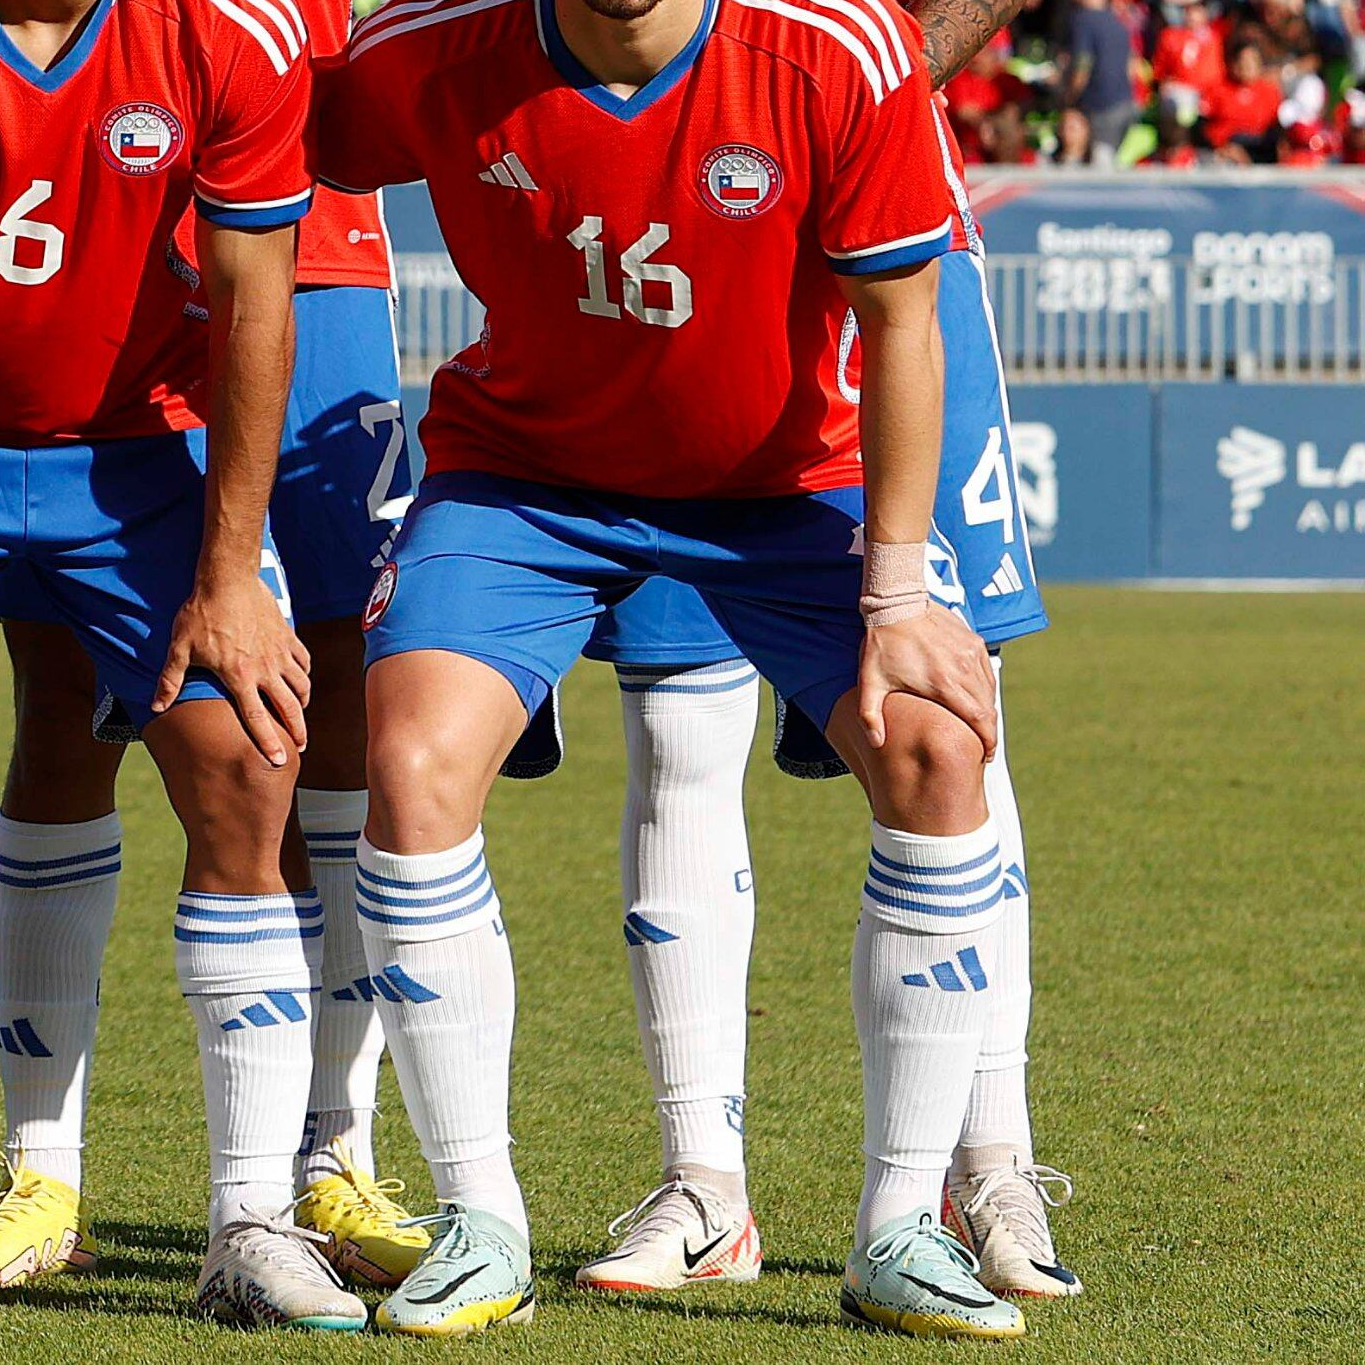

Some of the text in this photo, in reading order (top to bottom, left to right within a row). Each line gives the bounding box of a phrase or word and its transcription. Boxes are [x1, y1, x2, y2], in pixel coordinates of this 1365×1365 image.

[104, 105, 176, 133] COMITE OLIMPICO
[121, 163, 158, 174] CHILE
[702, 147, 775, 175] COMITE OLIMPICO
[722, 206, 758, 217] CHILE
[566, 215, 693, 327] 16
[359, 400, 415, 522] 2
[961, 426, 1015, 544] 4
